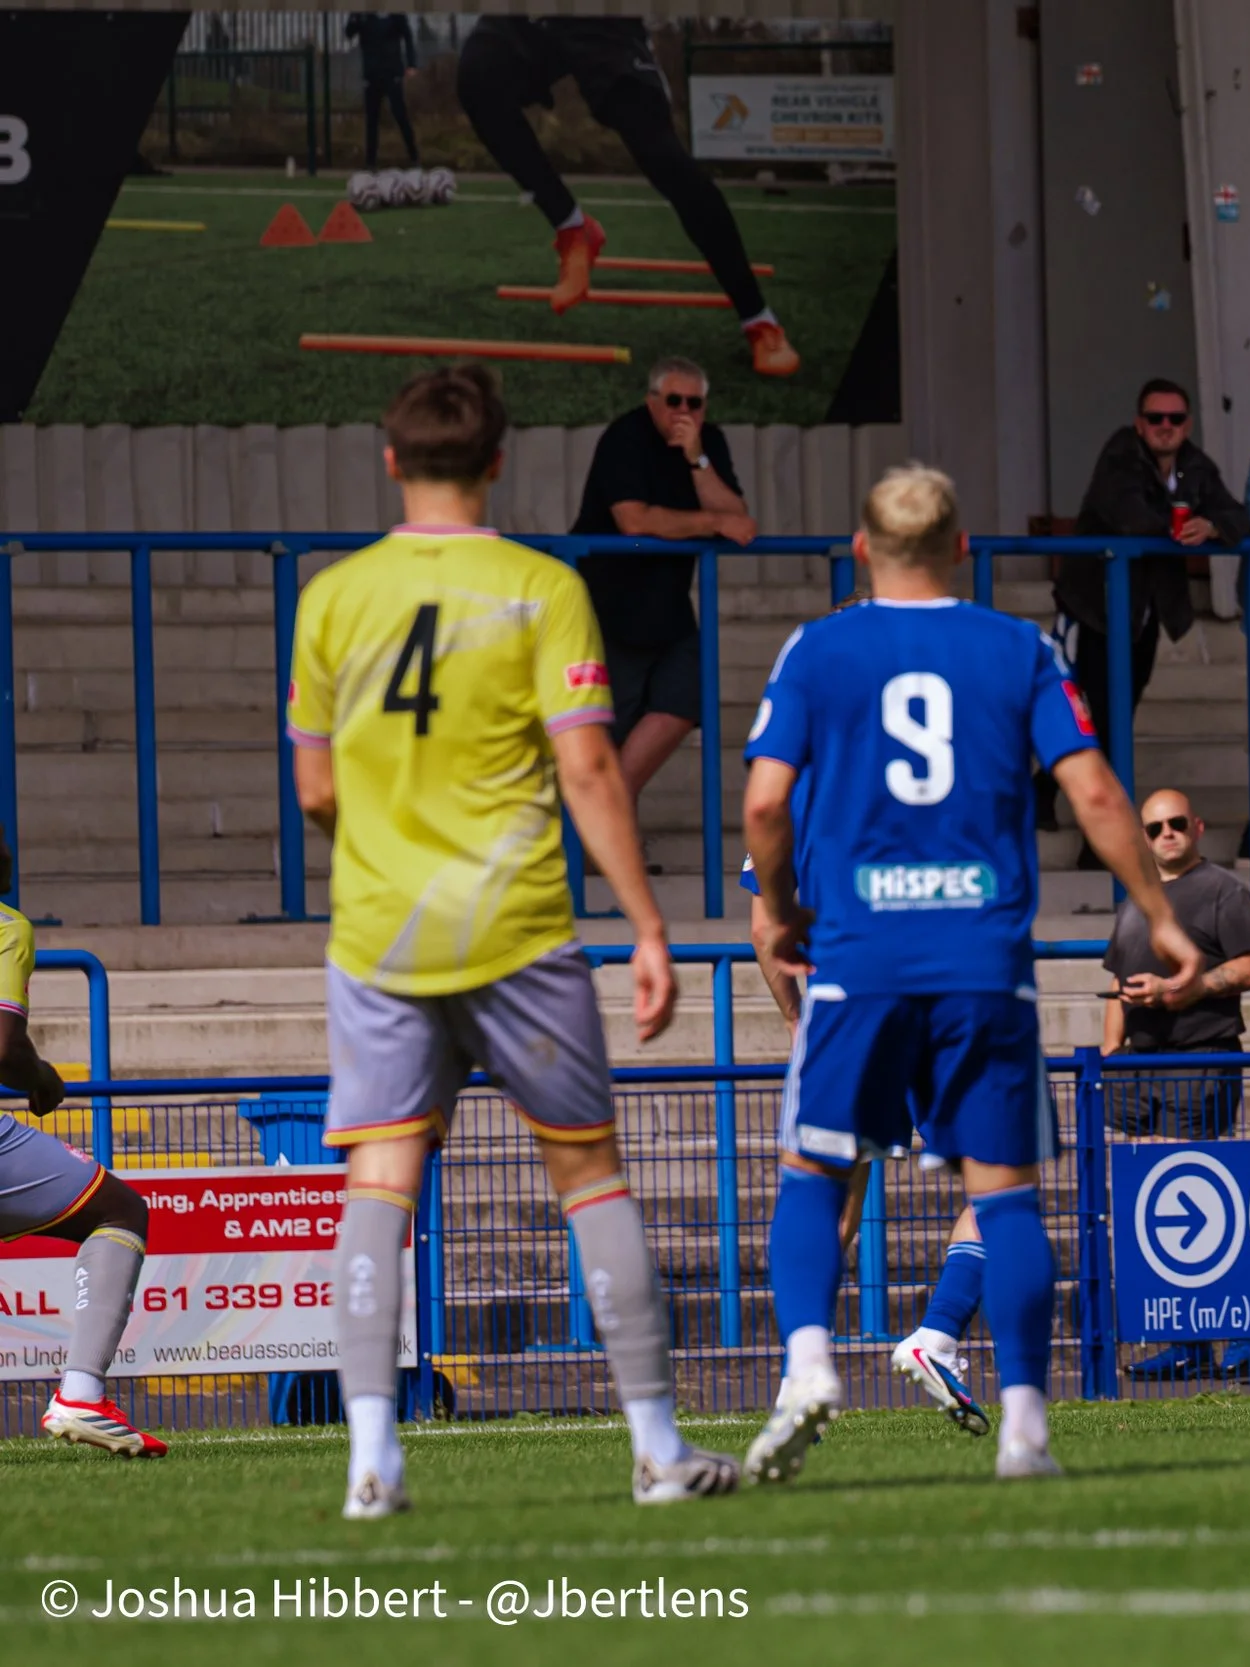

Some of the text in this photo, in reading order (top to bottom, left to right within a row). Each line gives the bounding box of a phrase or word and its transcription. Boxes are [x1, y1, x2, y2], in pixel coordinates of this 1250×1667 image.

[383, 602, 440, 736] 4
[881, 671, 955, 806] 9
[224, 1220, 244, 1238] &
[249, 1218, 311, 1237] AM2
[130, 1285, 189, 1312] 61
[205, 1283, 283, 1310] 339
[1144, 1297, 1183, 1331] HPE
[1190, 1294, 1250, 1332] (m/c)
